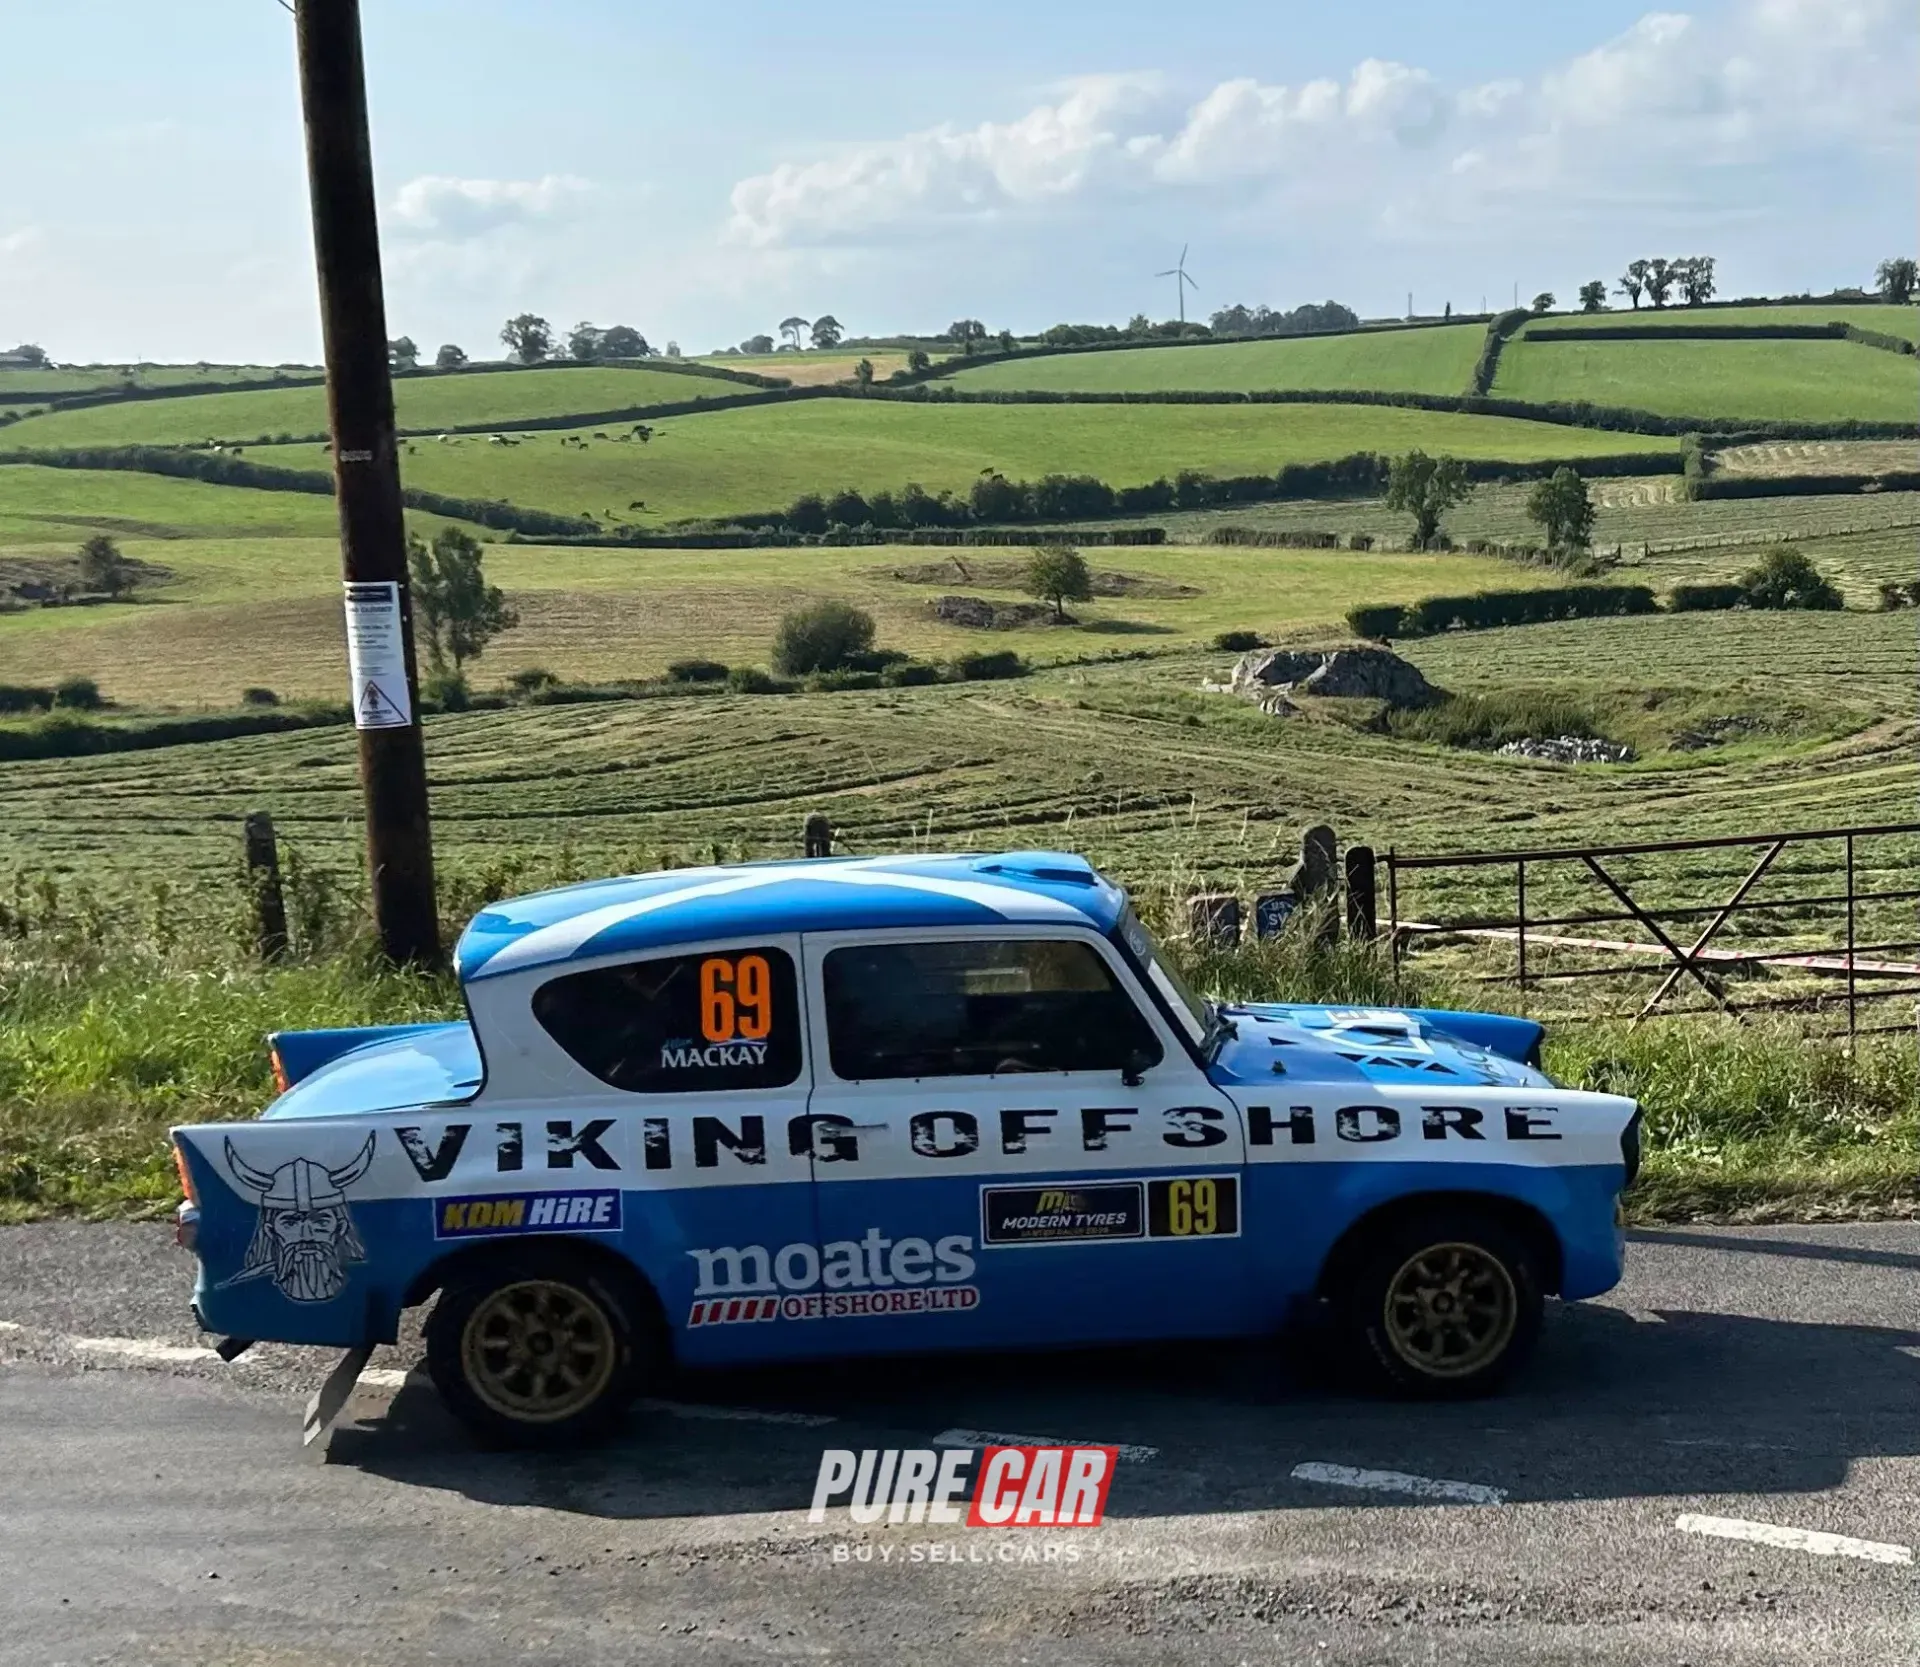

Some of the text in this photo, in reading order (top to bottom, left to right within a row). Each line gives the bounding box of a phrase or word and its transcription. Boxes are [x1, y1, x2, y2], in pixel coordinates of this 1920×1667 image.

[700, 955, 772, 1043] 69
[661, 1045, 768, 1069] MACKAY
[394, 1105, 1563, 1182] VIKING OFFSHORE
[442, 1199, 526, 1232] KDM
[1002, 1212, 1127, 1230] MODERN TYRES
[1168, 1179, 1217, 1236] 69
[686, 1227, 977, 1296] moates
[783, 1287, 979, 1319] OFFSHORE LTD
